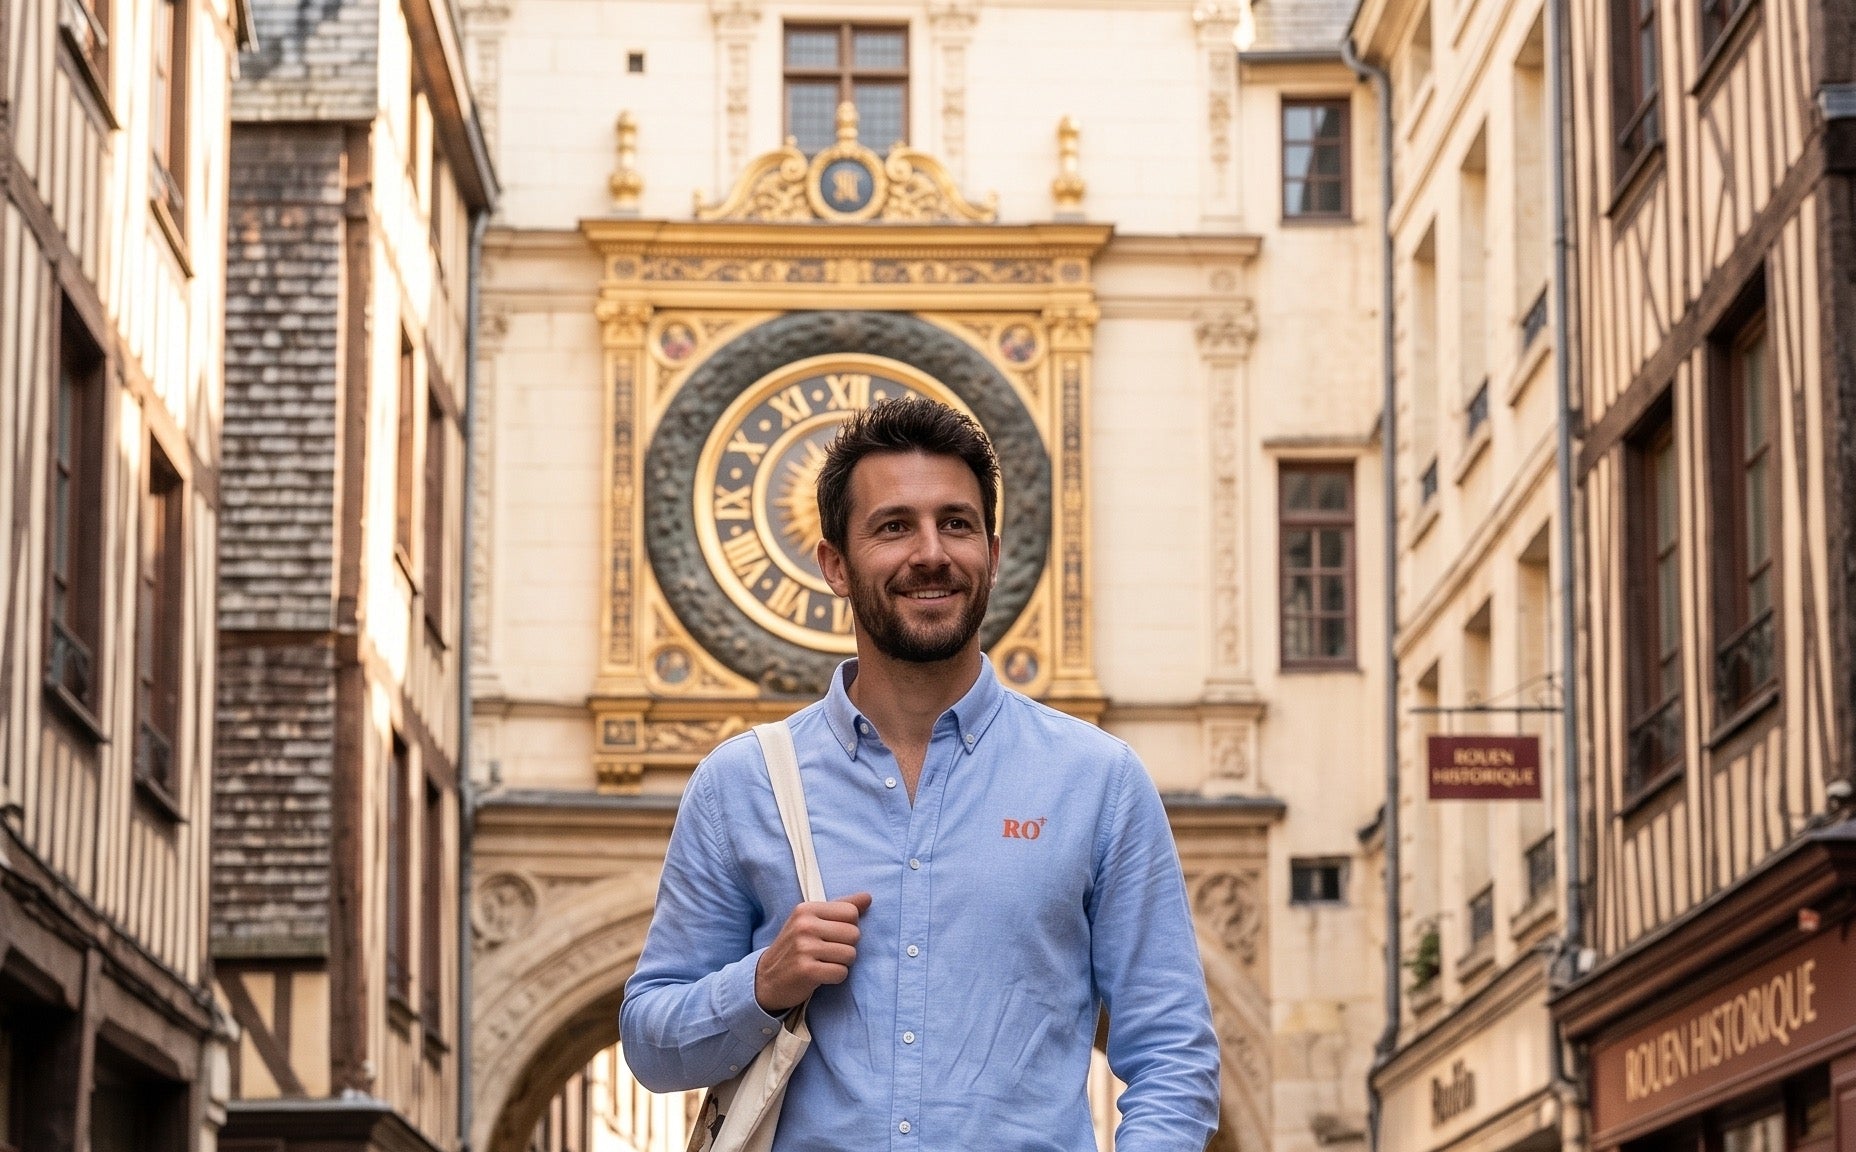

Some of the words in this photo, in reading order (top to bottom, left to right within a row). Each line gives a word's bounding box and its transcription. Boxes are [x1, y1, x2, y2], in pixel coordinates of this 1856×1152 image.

[769, 385, 812, 428] XI
[825, 374, 871, 410] XII
[727, 429, 768, 464] X
[714, 485, 752, 520] IX
[1690, 959, 1817, 1075] HISTORIQUE
